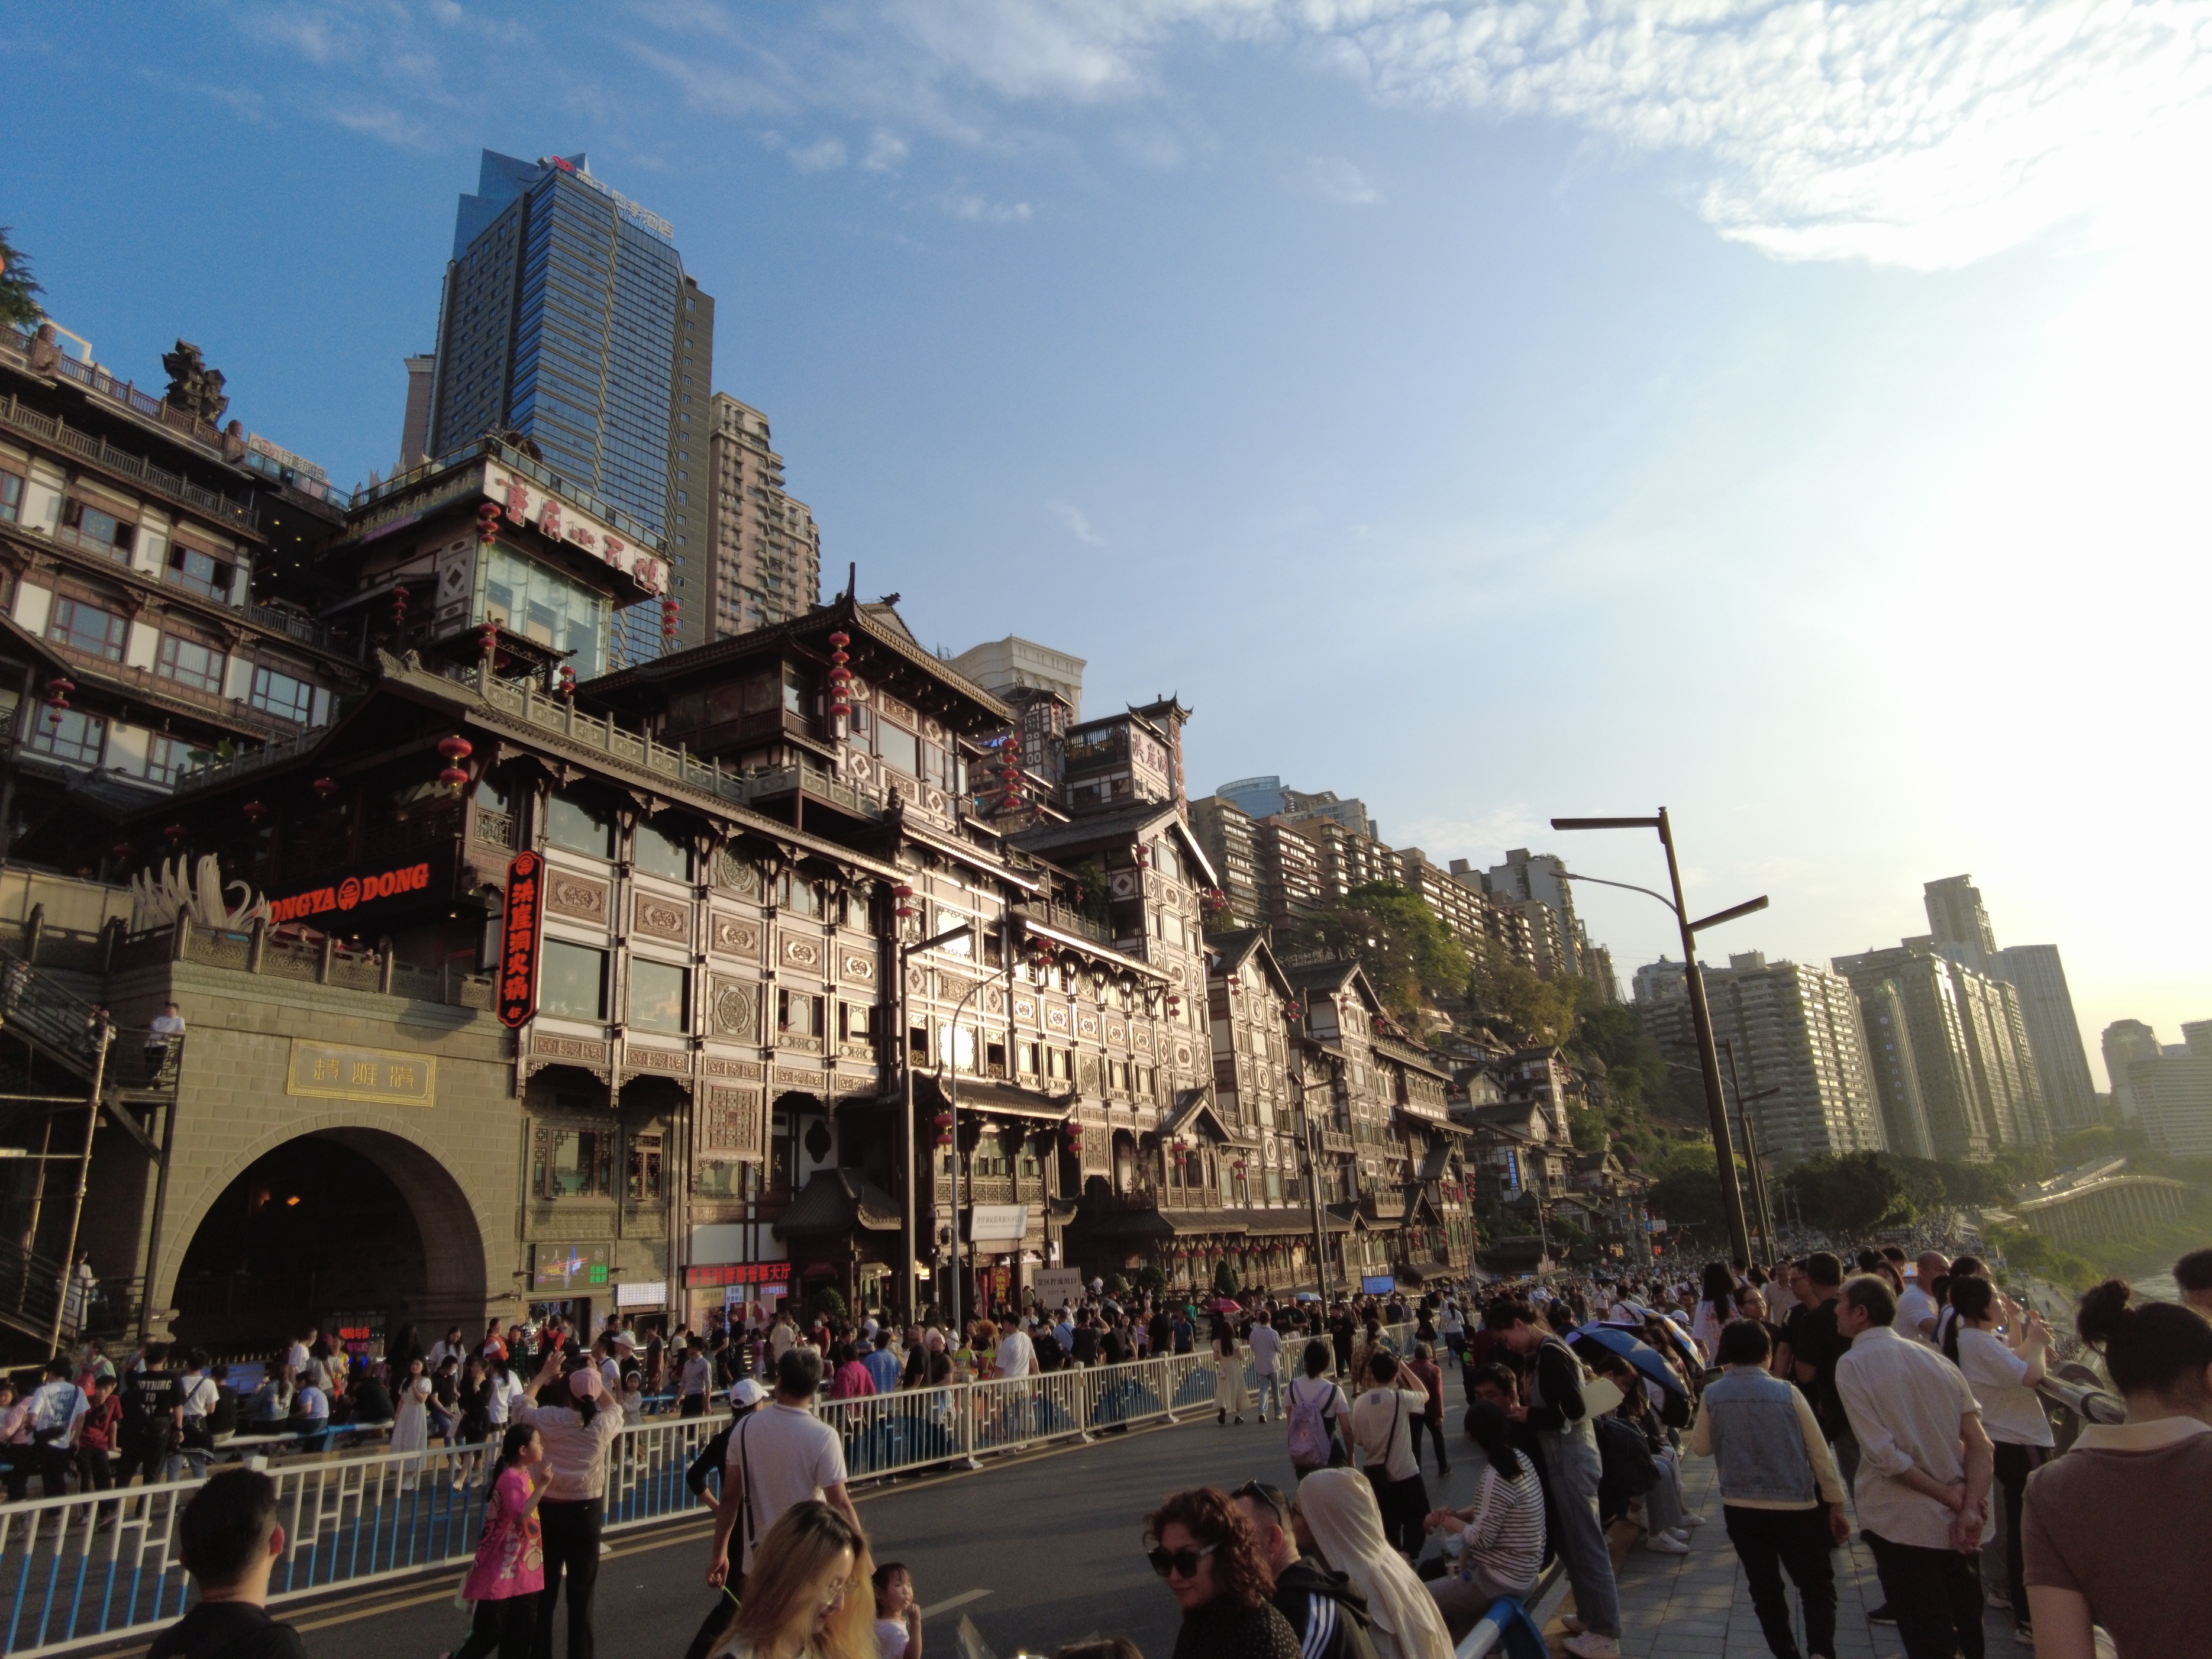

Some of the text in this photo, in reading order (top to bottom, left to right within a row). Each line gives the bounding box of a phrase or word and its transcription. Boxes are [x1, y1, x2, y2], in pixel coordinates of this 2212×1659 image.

[282, 450, 325, 480] 行影旅拍
[1132, 733, 1170, 780] 洪崖洞
[253, 863, 429, 924] ONGYA DONG
[504, 878, 535, 1000] 洪崖洞火锅
[508, 1006, 522, 1019] 4F
[1038, 1277, 1077, 1286] 景区控流出口
[146, 1393, 156, 1402] TO
